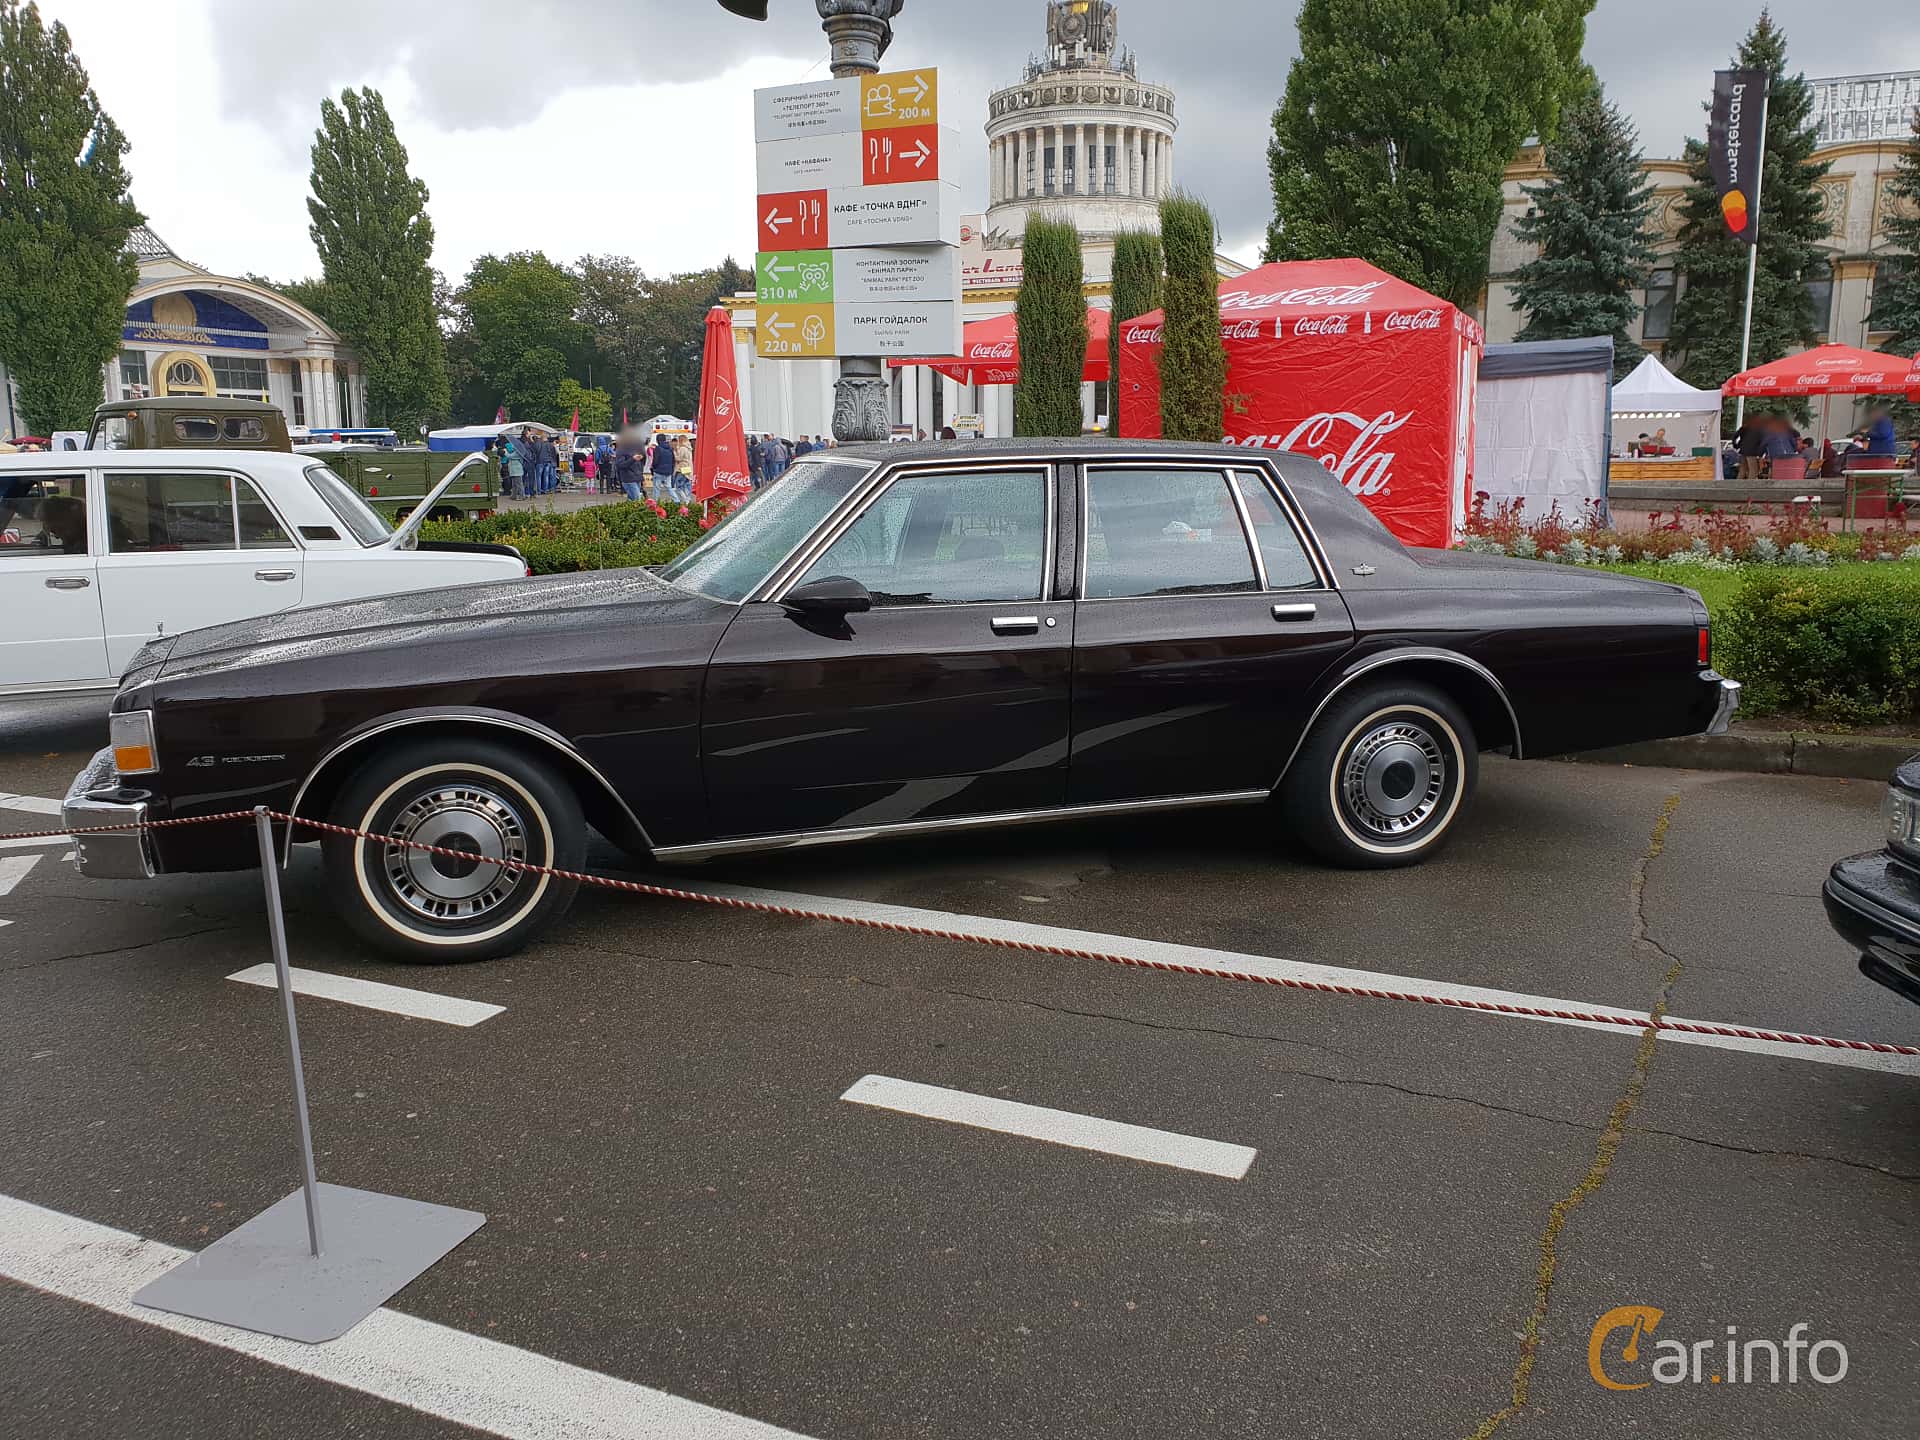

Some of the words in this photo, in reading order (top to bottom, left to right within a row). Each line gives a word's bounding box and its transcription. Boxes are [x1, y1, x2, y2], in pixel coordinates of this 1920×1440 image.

[898, 107, 919, 120] 200
[834, 203, 859, 213] КАФЕ
[860, 201, 895, 211] «ТОЧКА
[897, 199, 927, 210] ВДНГ»
[761, 287, 785, 300] 310
[854, 316, 878, 325] ПАРК
[879, 314, 928, 326] ГОЙДАЛОК
[764, 340, 788, 353] 220
[970, 342, 1016, 359] Coca-Cola
